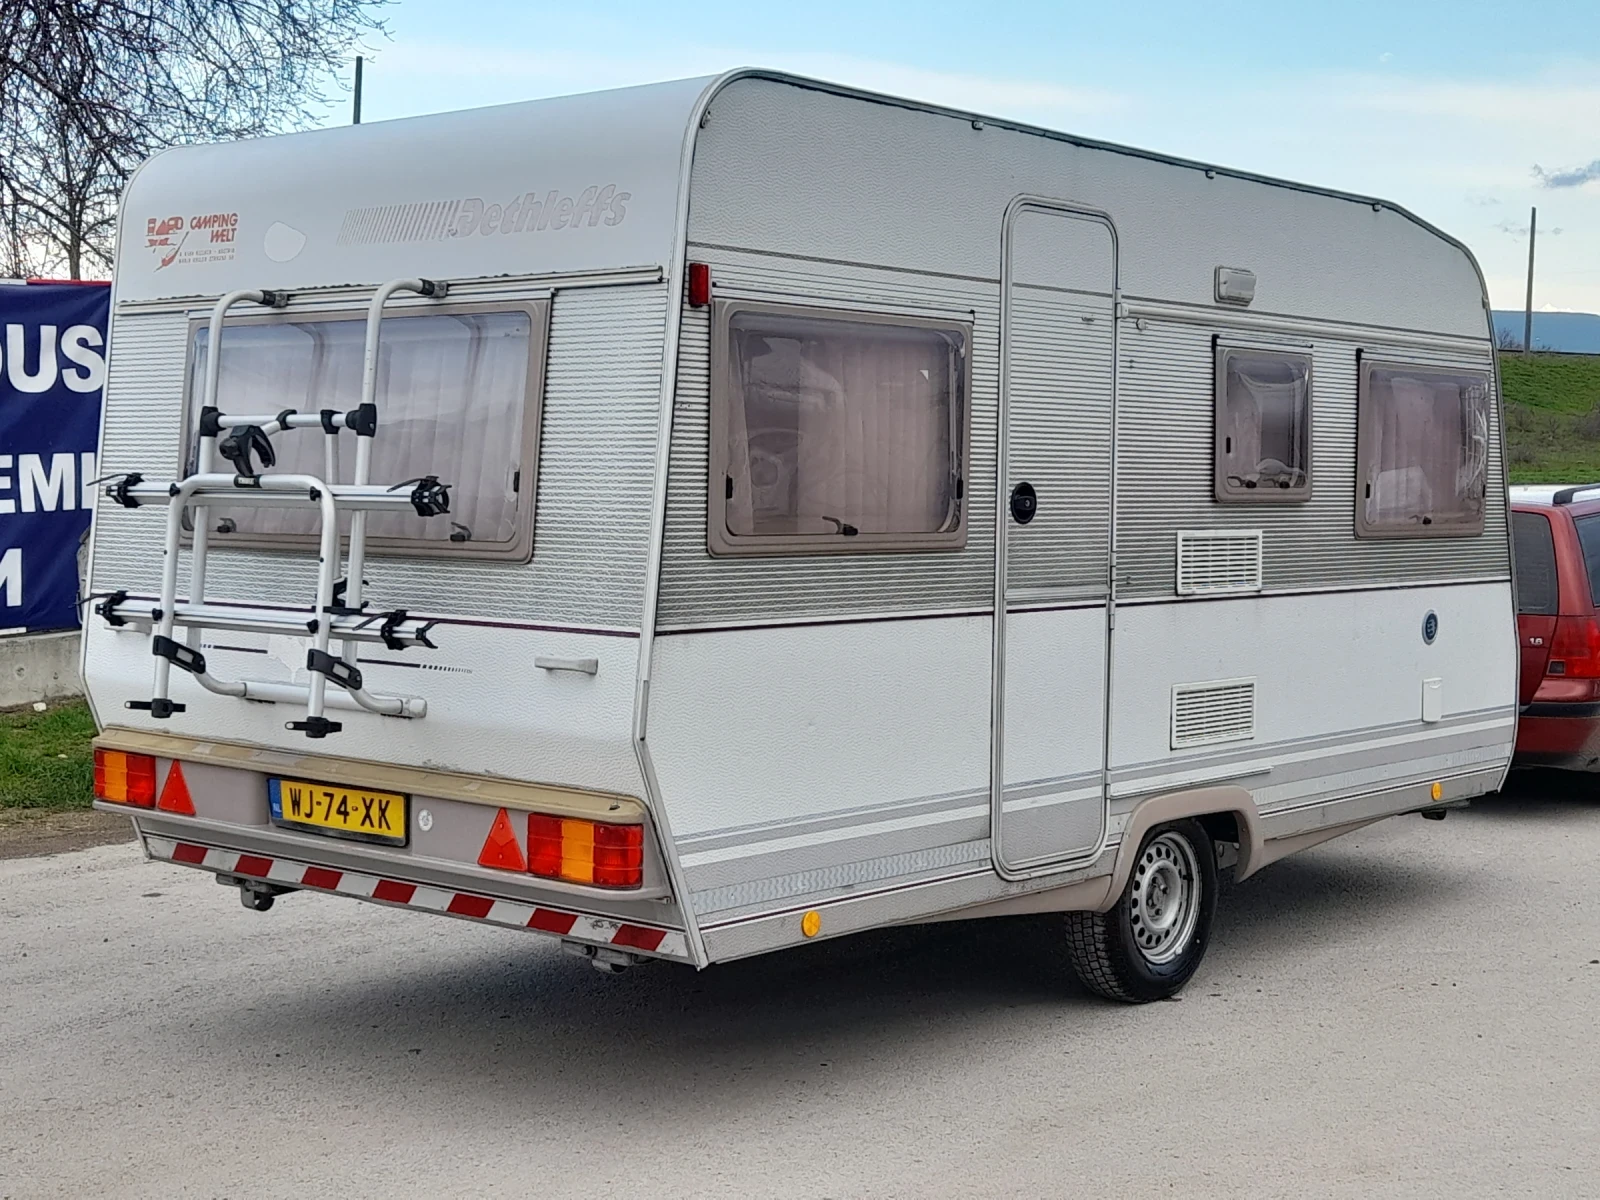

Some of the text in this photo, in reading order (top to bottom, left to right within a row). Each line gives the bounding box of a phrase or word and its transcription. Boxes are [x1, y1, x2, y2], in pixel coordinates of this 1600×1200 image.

[190, 213, 238, 230] CAMPING
[453, 184, 631, 238] Dethleffs
[210, 228, 237, 243] WELT
[0, 323, 105, 393] US
[289, 787, 391, 831] WJ-74-XK
